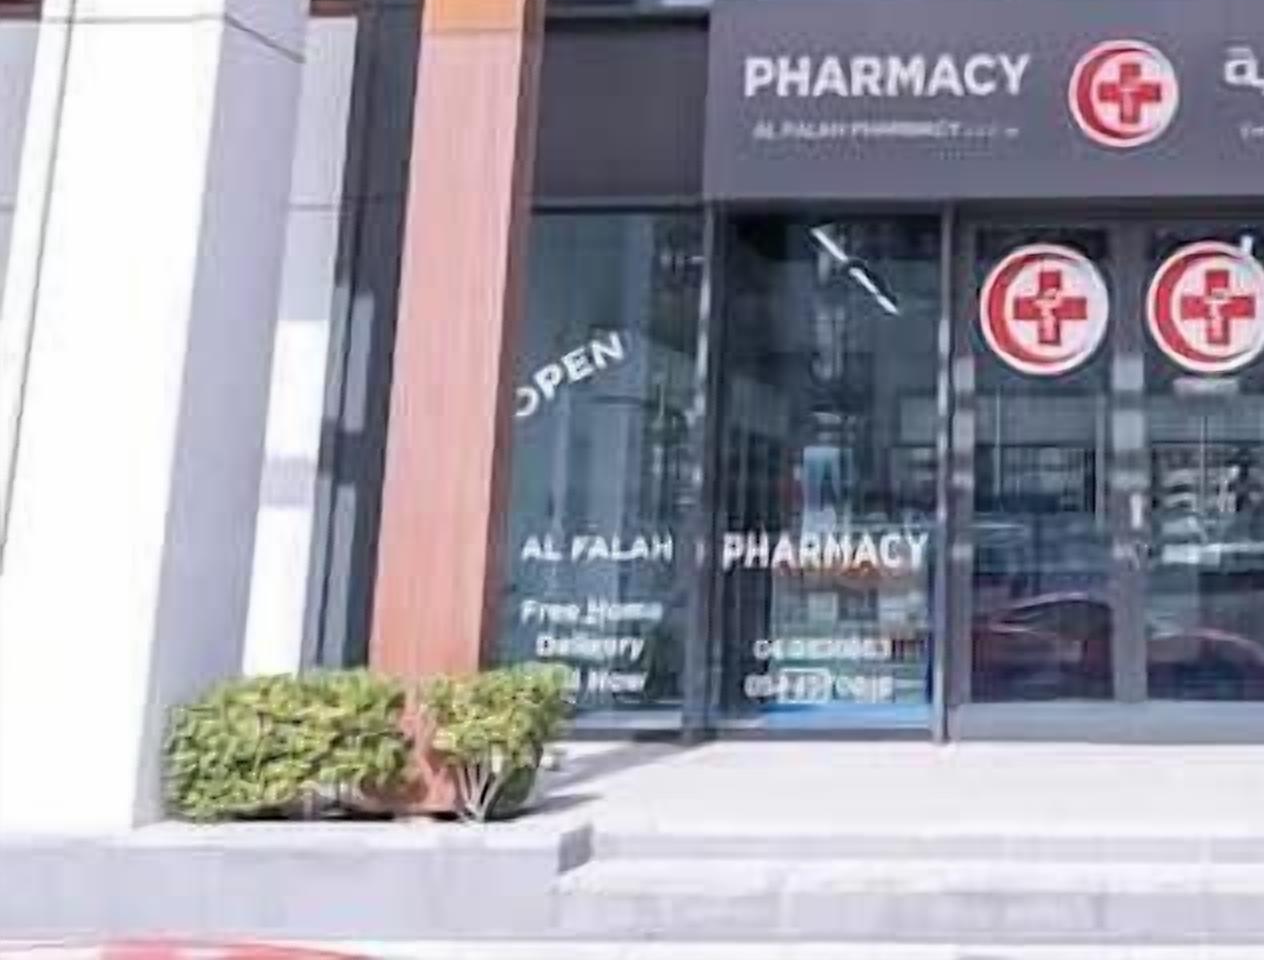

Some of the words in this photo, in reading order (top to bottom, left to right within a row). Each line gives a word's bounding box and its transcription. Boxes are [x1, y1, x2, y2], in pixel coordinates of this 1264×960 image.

[743, 52, 1031, 100] PHARMACY
[521, 534, 563, 561] AL
[571, 533, 674, 562] FALAH
[722, 529, 929, 570] PHARMACY
[520, 599, 580, 624] Free
[586, 597, 664, 628] Home
[535, 633, 646, 662] Delivery
